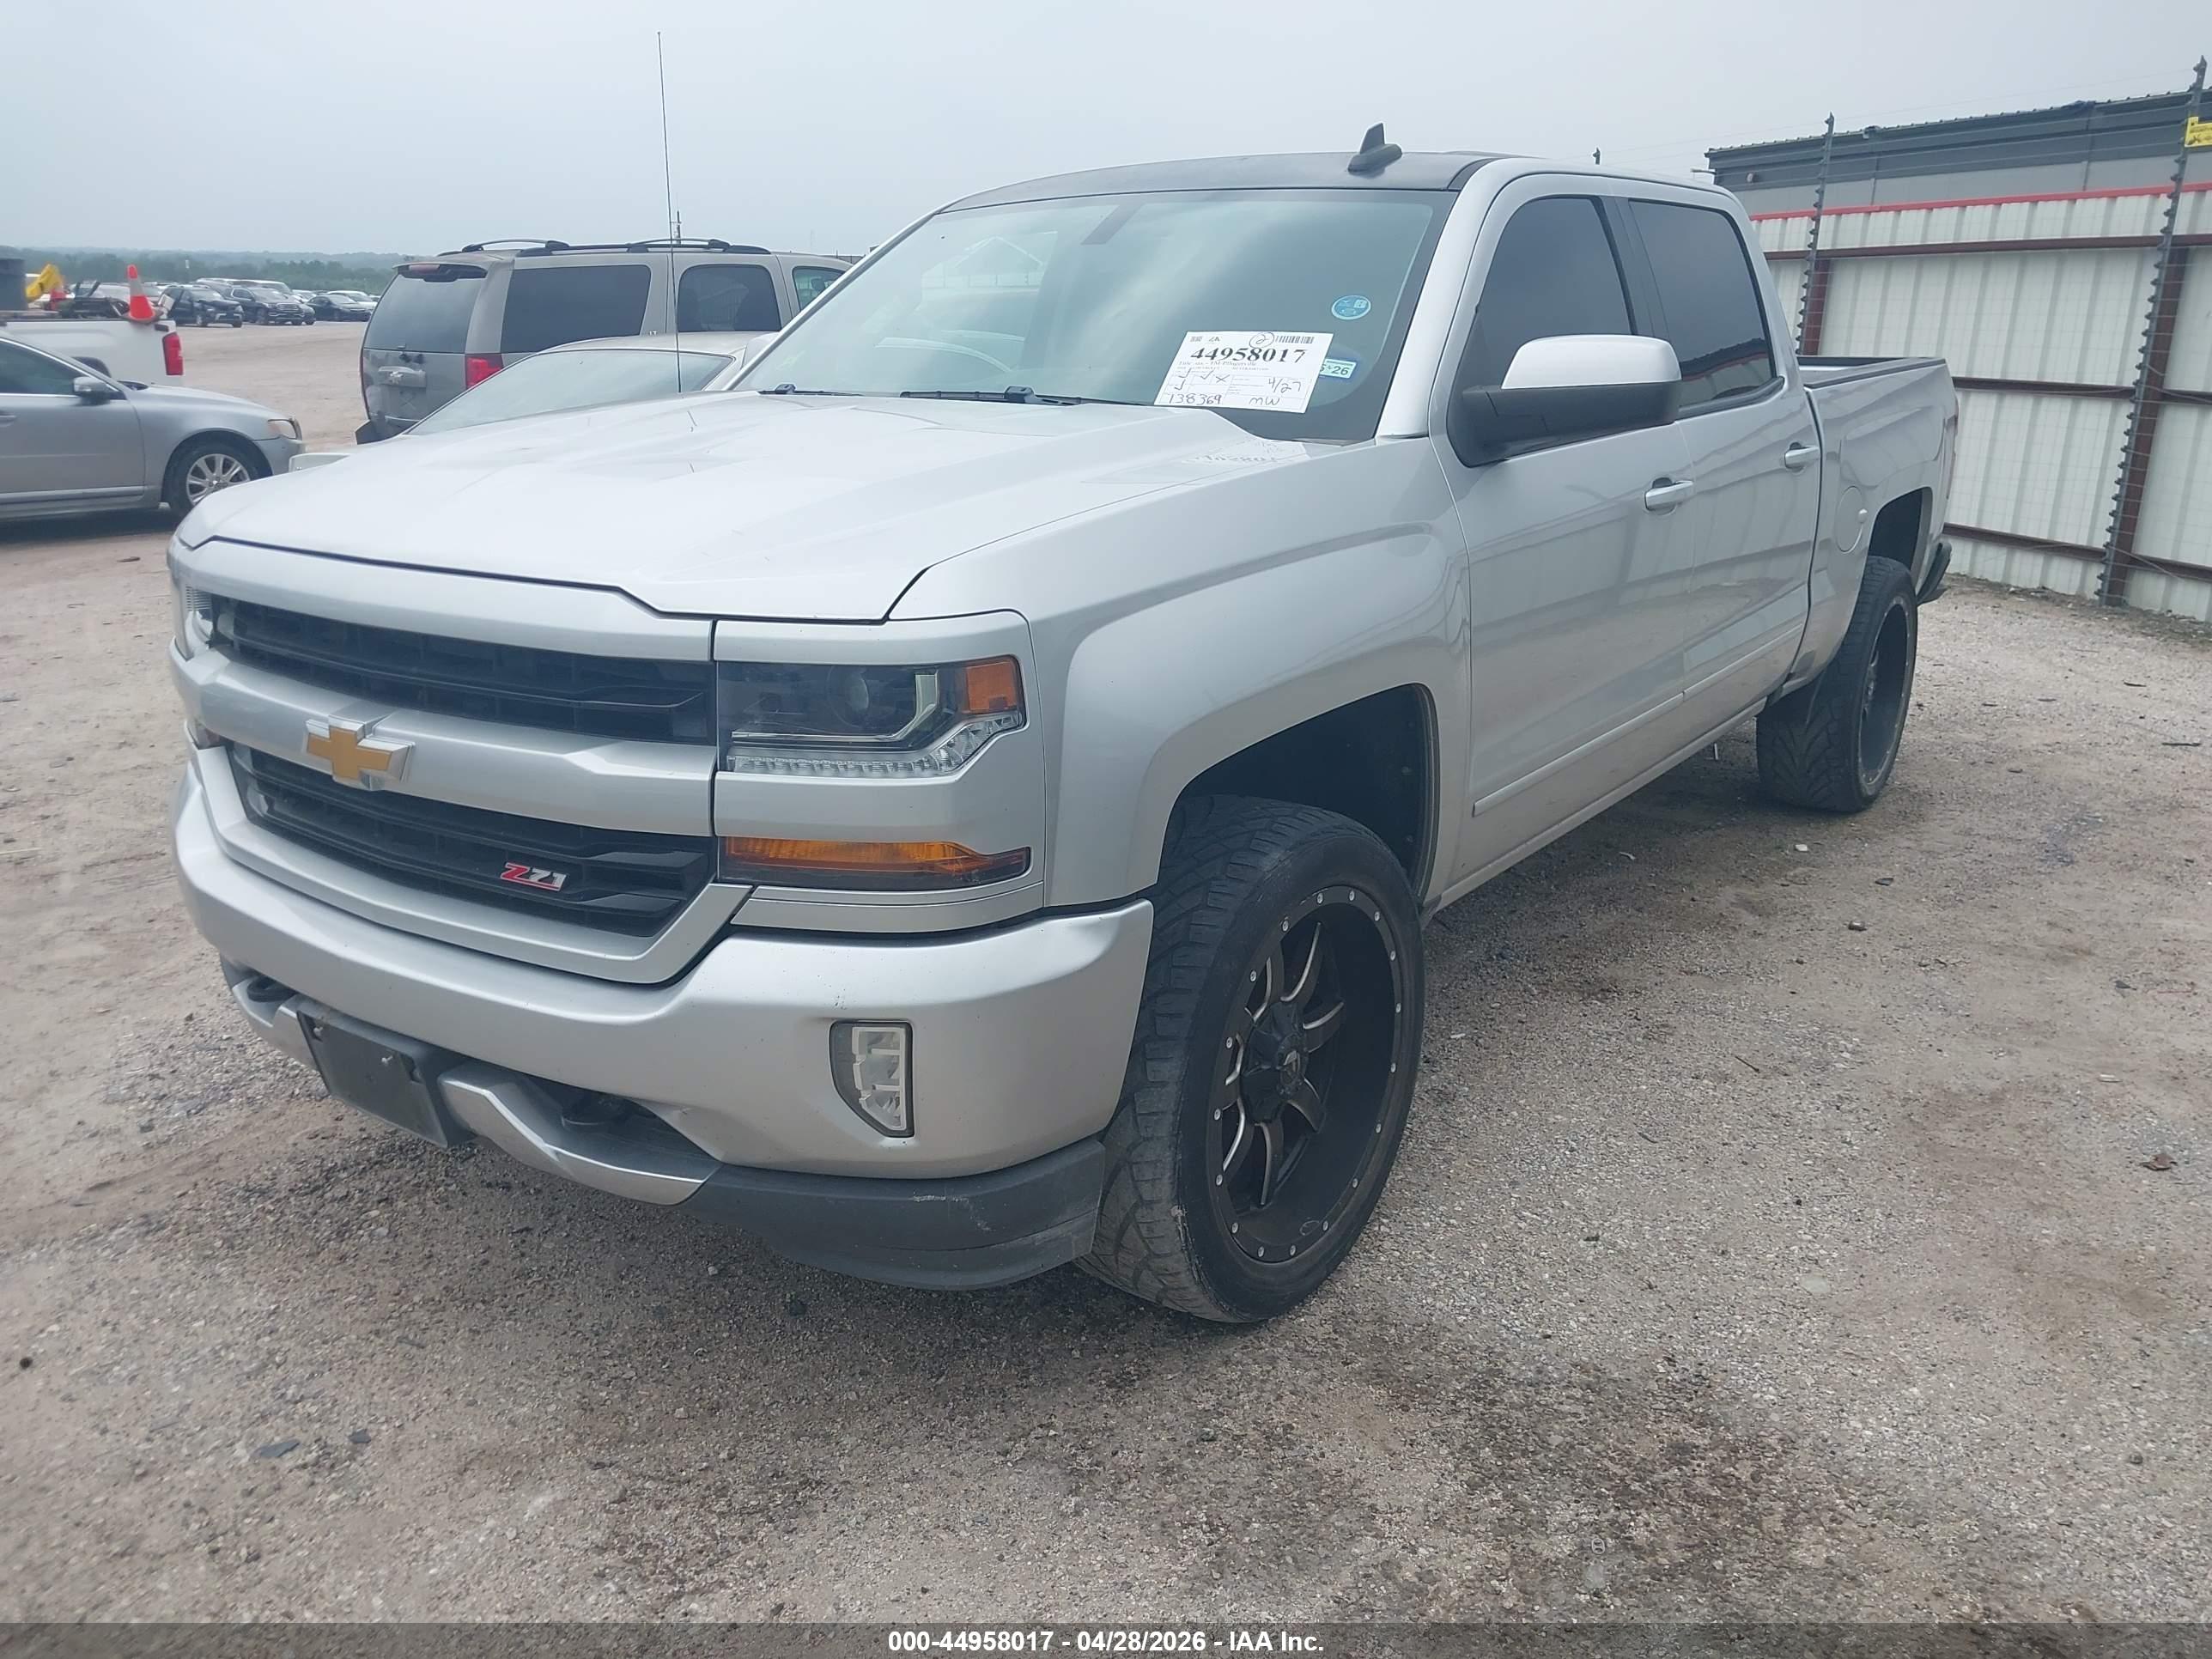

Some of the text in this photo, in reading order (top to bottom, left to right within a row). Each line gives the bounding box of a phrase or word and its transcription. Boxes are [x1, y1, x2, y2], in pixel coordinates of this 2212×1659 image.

[1190, 347, 1308, 363] 44958017
[1332, 366, 1350, 375] 26
[1268, 377, 1301, 393] 4/27
[1169, 393, 1222, 406] 138369
[500, 862, 567, 891] Z71
